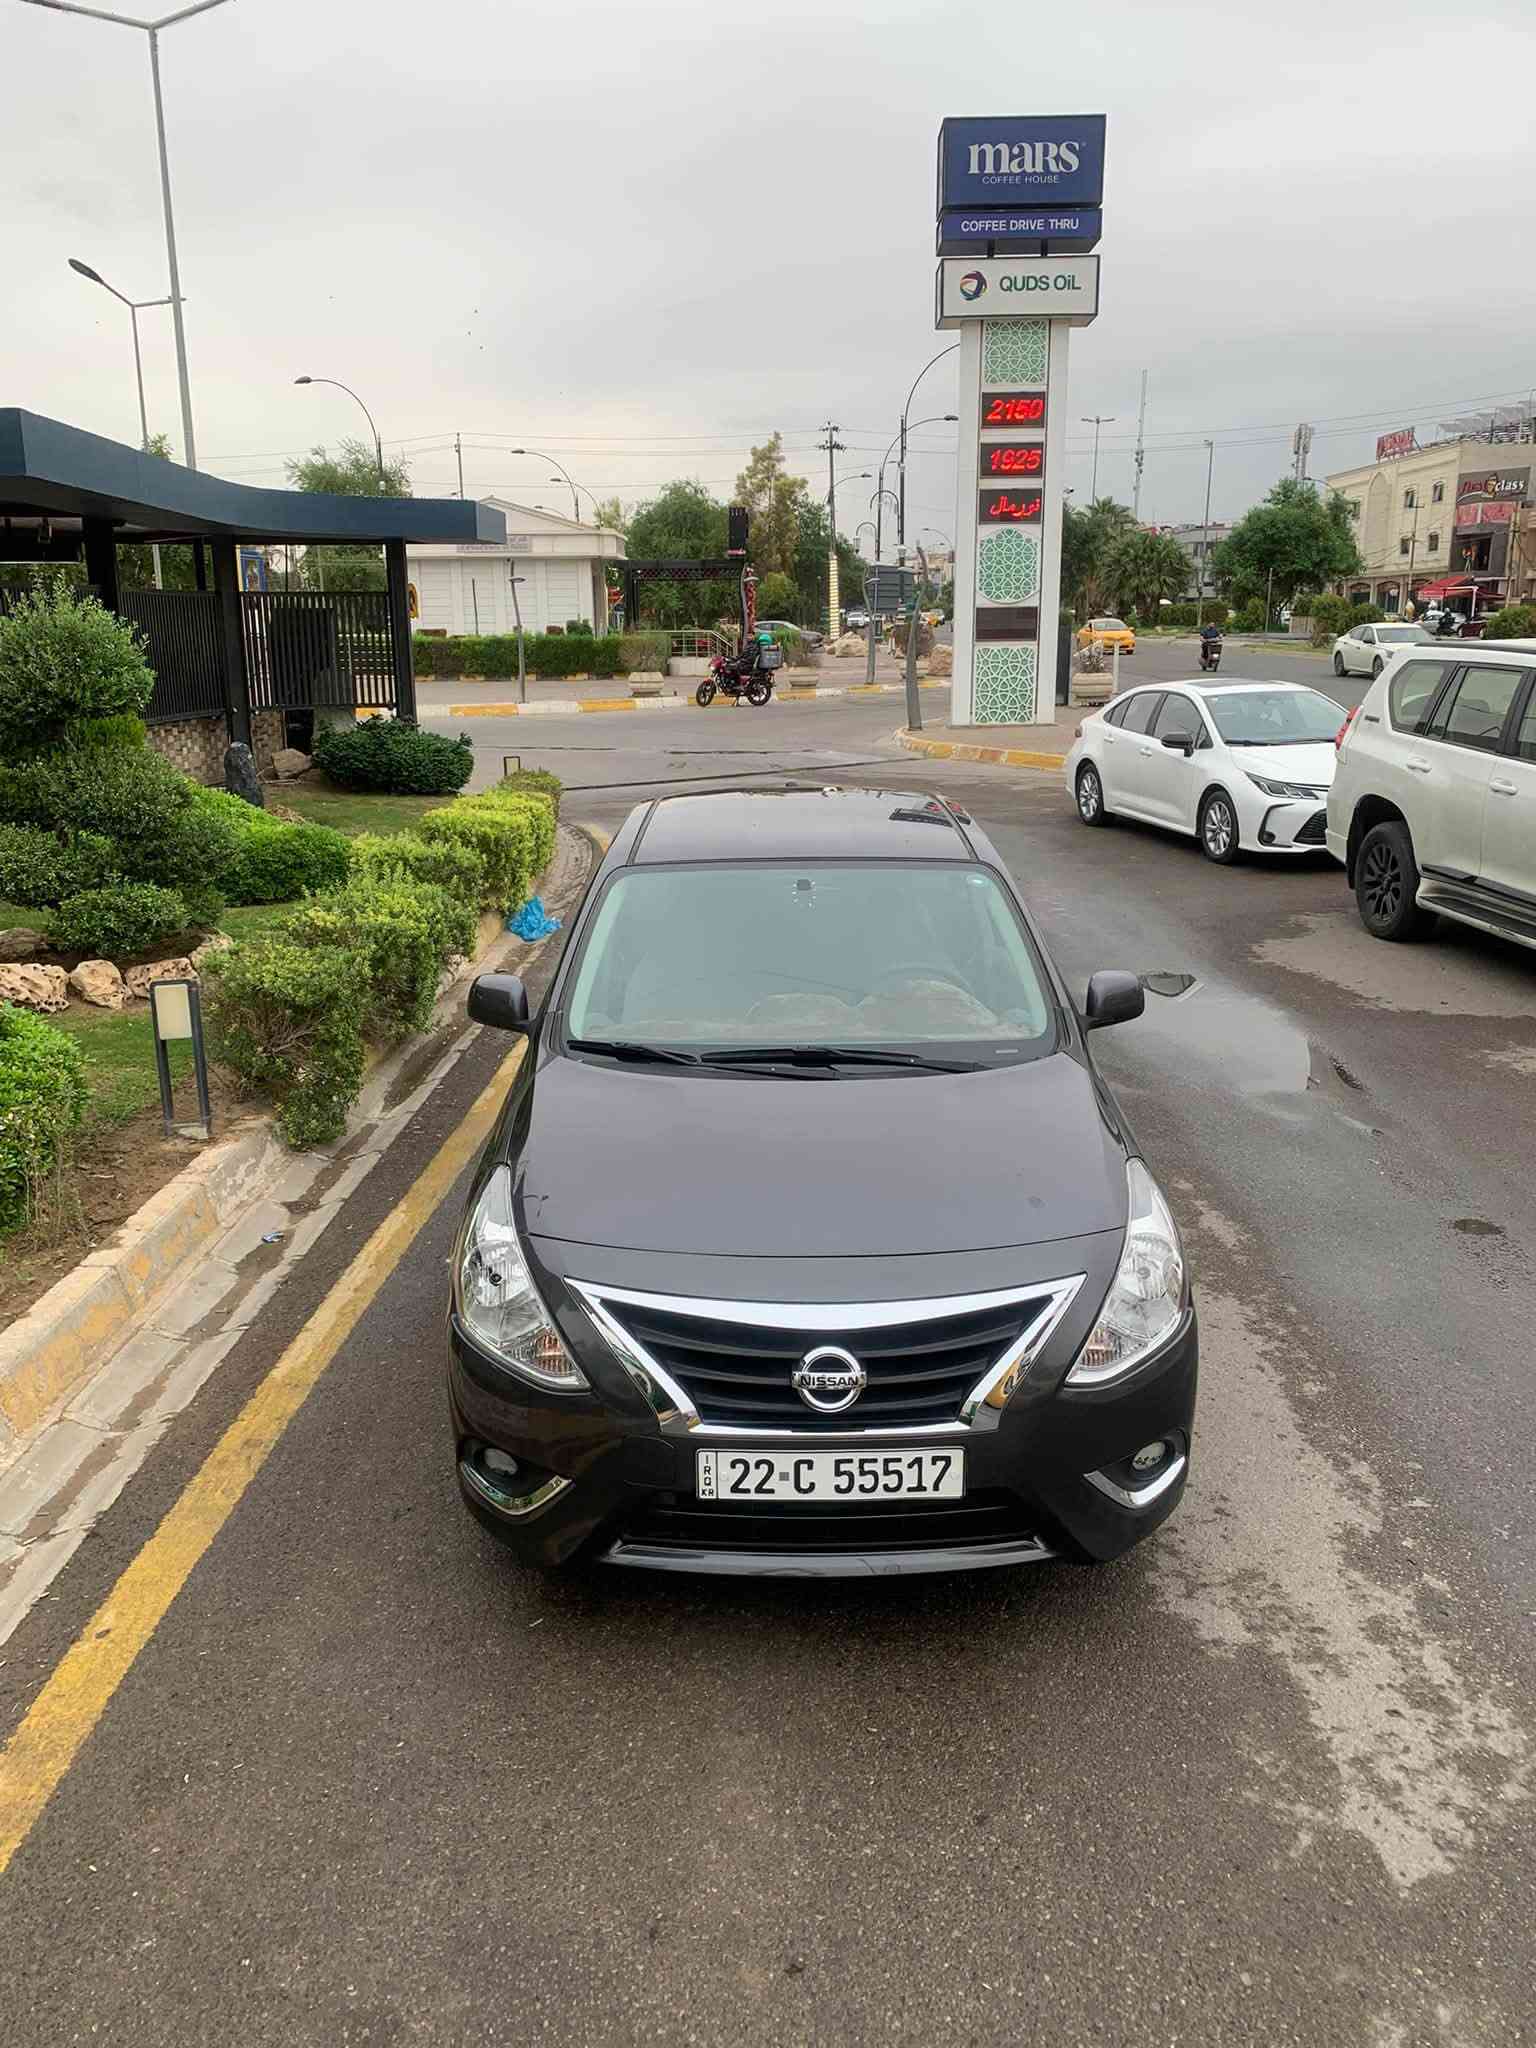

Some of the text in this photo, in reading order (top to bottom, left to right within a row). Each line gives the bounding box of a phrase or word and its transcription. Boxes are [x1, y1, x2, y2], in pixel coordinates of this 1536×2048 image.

[982, 174, 1060, 184] COFFEE HOUSE
[961, 218, 1079, 231] COFFEE DRIVE THRU
[1000, 275, 1050, 292] QUDS
[987, 399, 1043, 420] 2150
[991, 449, 1041, 470] 1925
[1495, 480, 1524, 492] class
[800, 1376, 858, 1386] NISSAN
[834, 1456, 952, 1494] 55517
